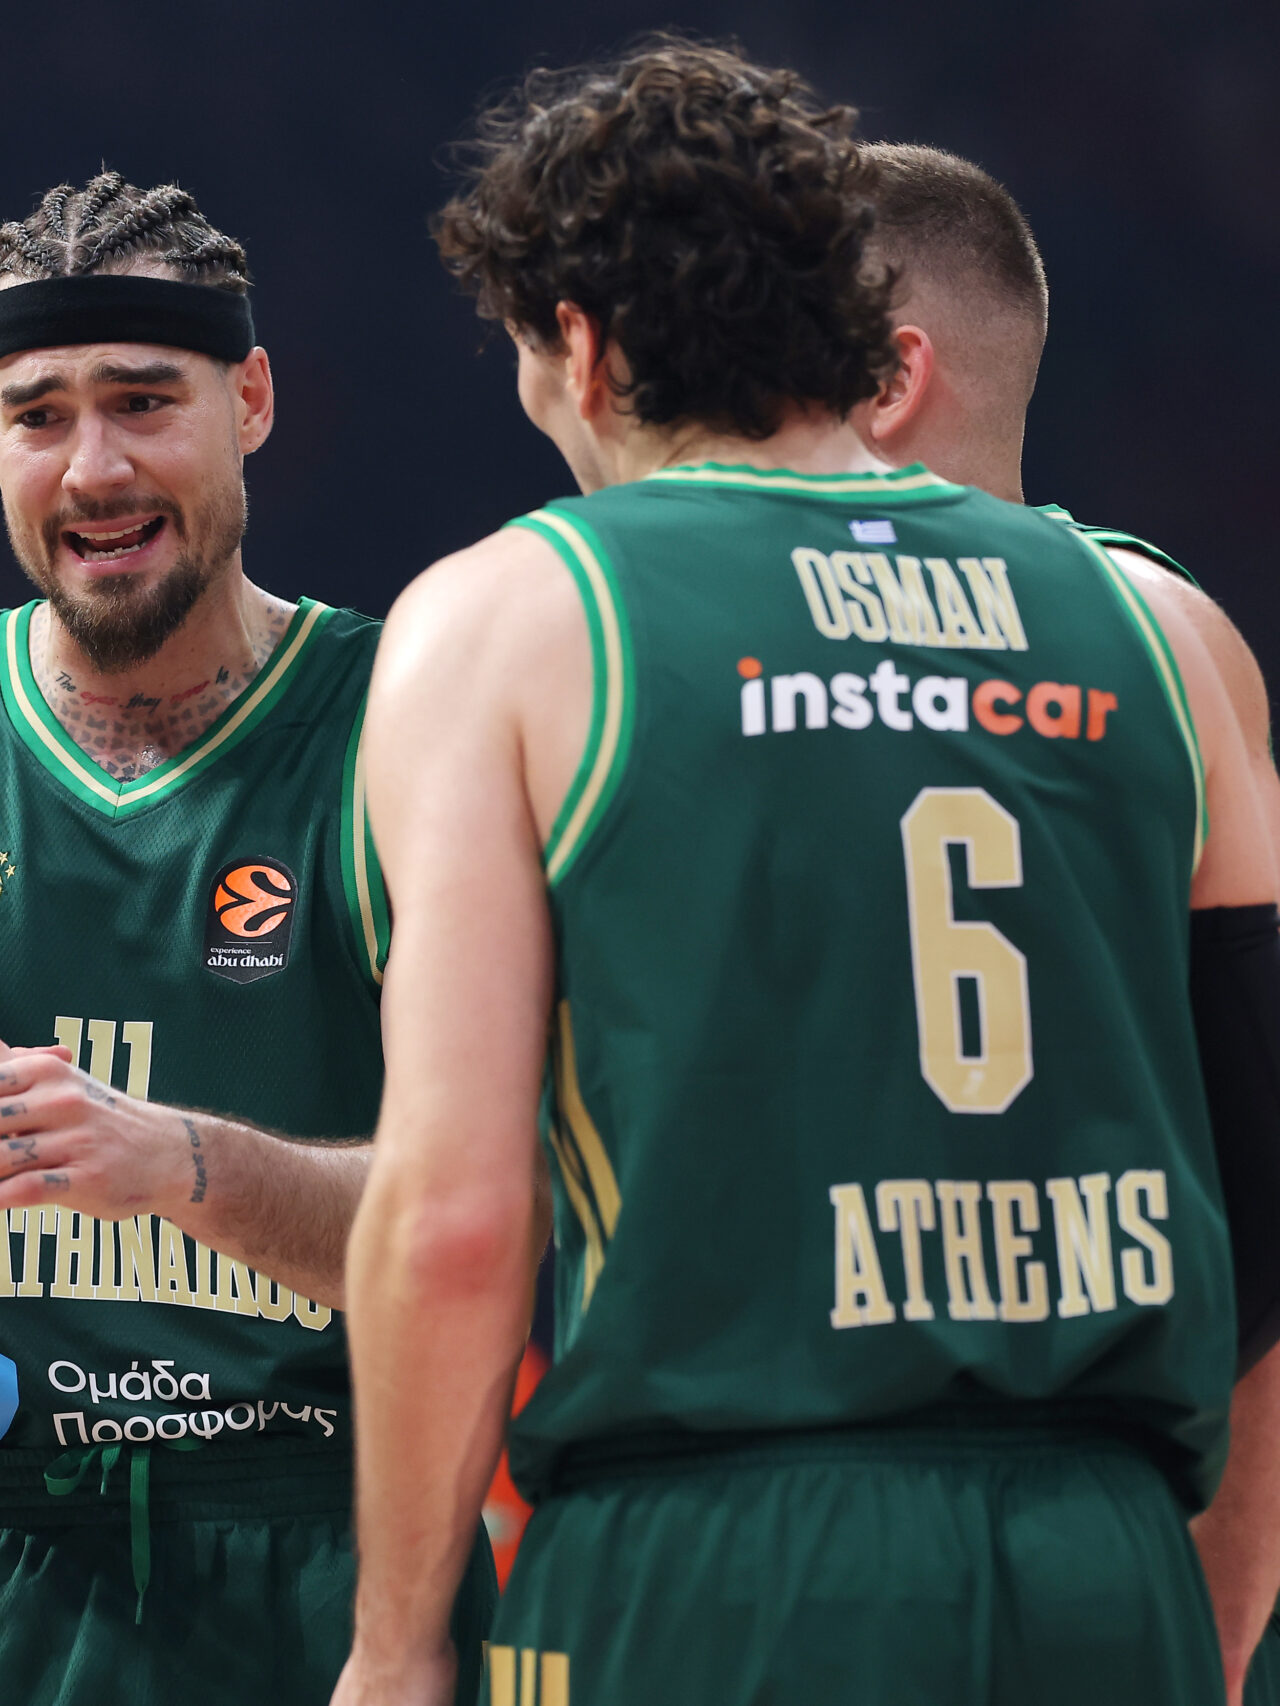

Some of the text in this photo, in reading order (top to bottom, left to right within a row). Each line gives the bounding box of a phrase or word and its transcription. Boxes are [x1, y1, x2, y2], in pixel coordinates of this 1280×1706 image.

[791, 547, 1028, 651] OSMAN
[737, 656, 1118, 741] instacar
[207, 953, 284, 967] abu dhabi
[900, 787, 1033, 1114] 6
[829, 1170, 1175, 1329] ATHENS
[48, 1360, 211, 1404] Ομάδα
